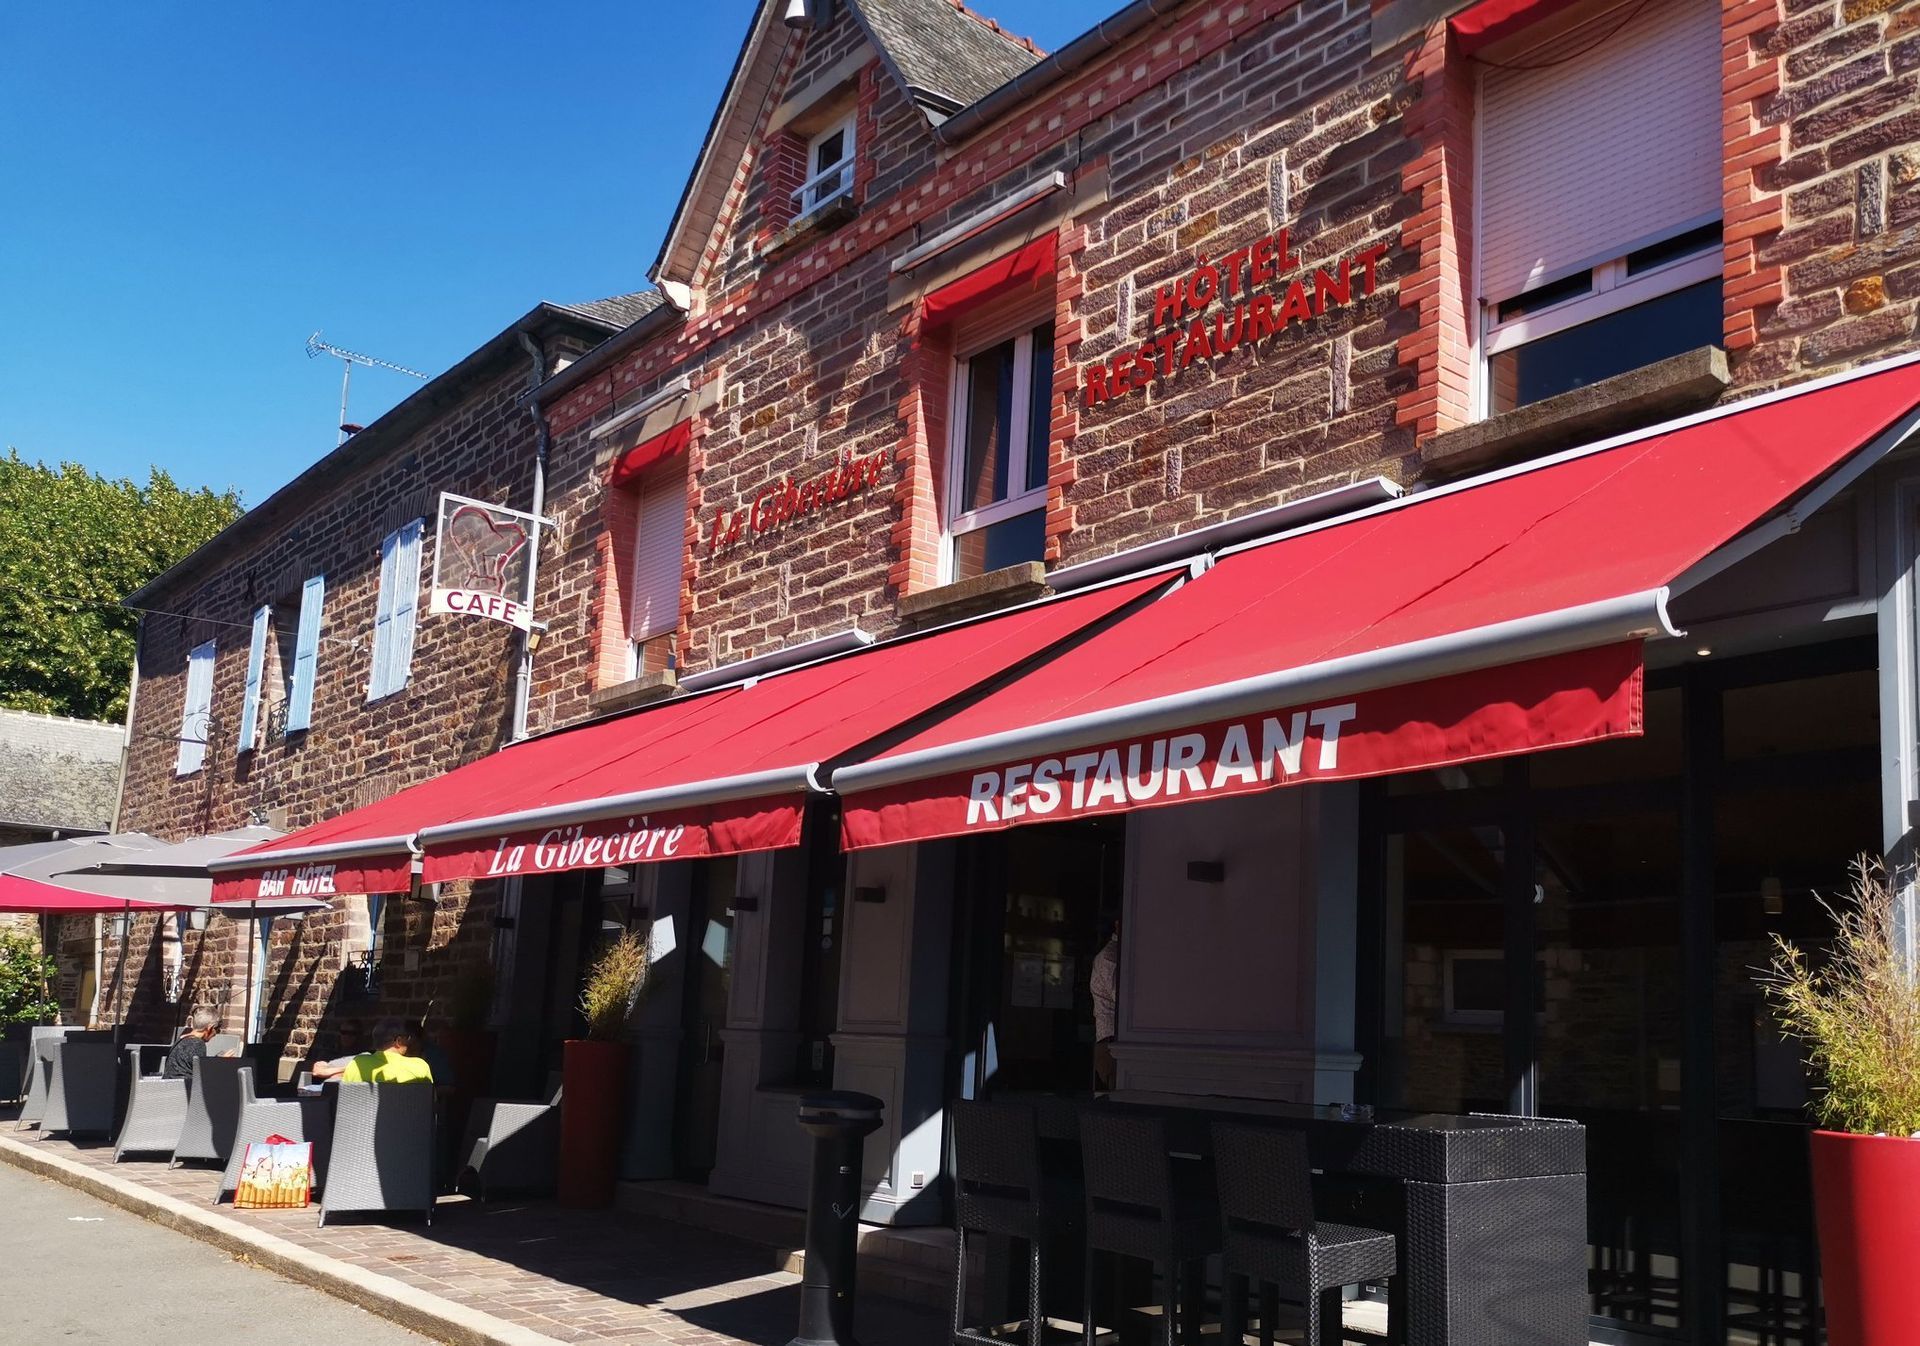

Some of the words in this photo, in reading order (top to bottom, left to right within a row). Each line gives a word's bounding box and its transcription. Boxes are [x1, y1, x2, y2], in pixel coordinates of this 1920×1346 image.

[1086, 244, 1387, 406] RESTAURANT
[1154, 228, 1299, 327] HÔTEL
[711, 506, 744, 549] La
[751, 449, 888, 533] Gibecière
[446, 591, 518, 622] CAFE
[966, 702, 1357, 825] RESTAURANT
[257, 869, 288, 897] BAR
[291, 861, 337, 895] HÔTEL
[487, 837, 526, 875] La
[534, 815, 685, 870] Gibecière
